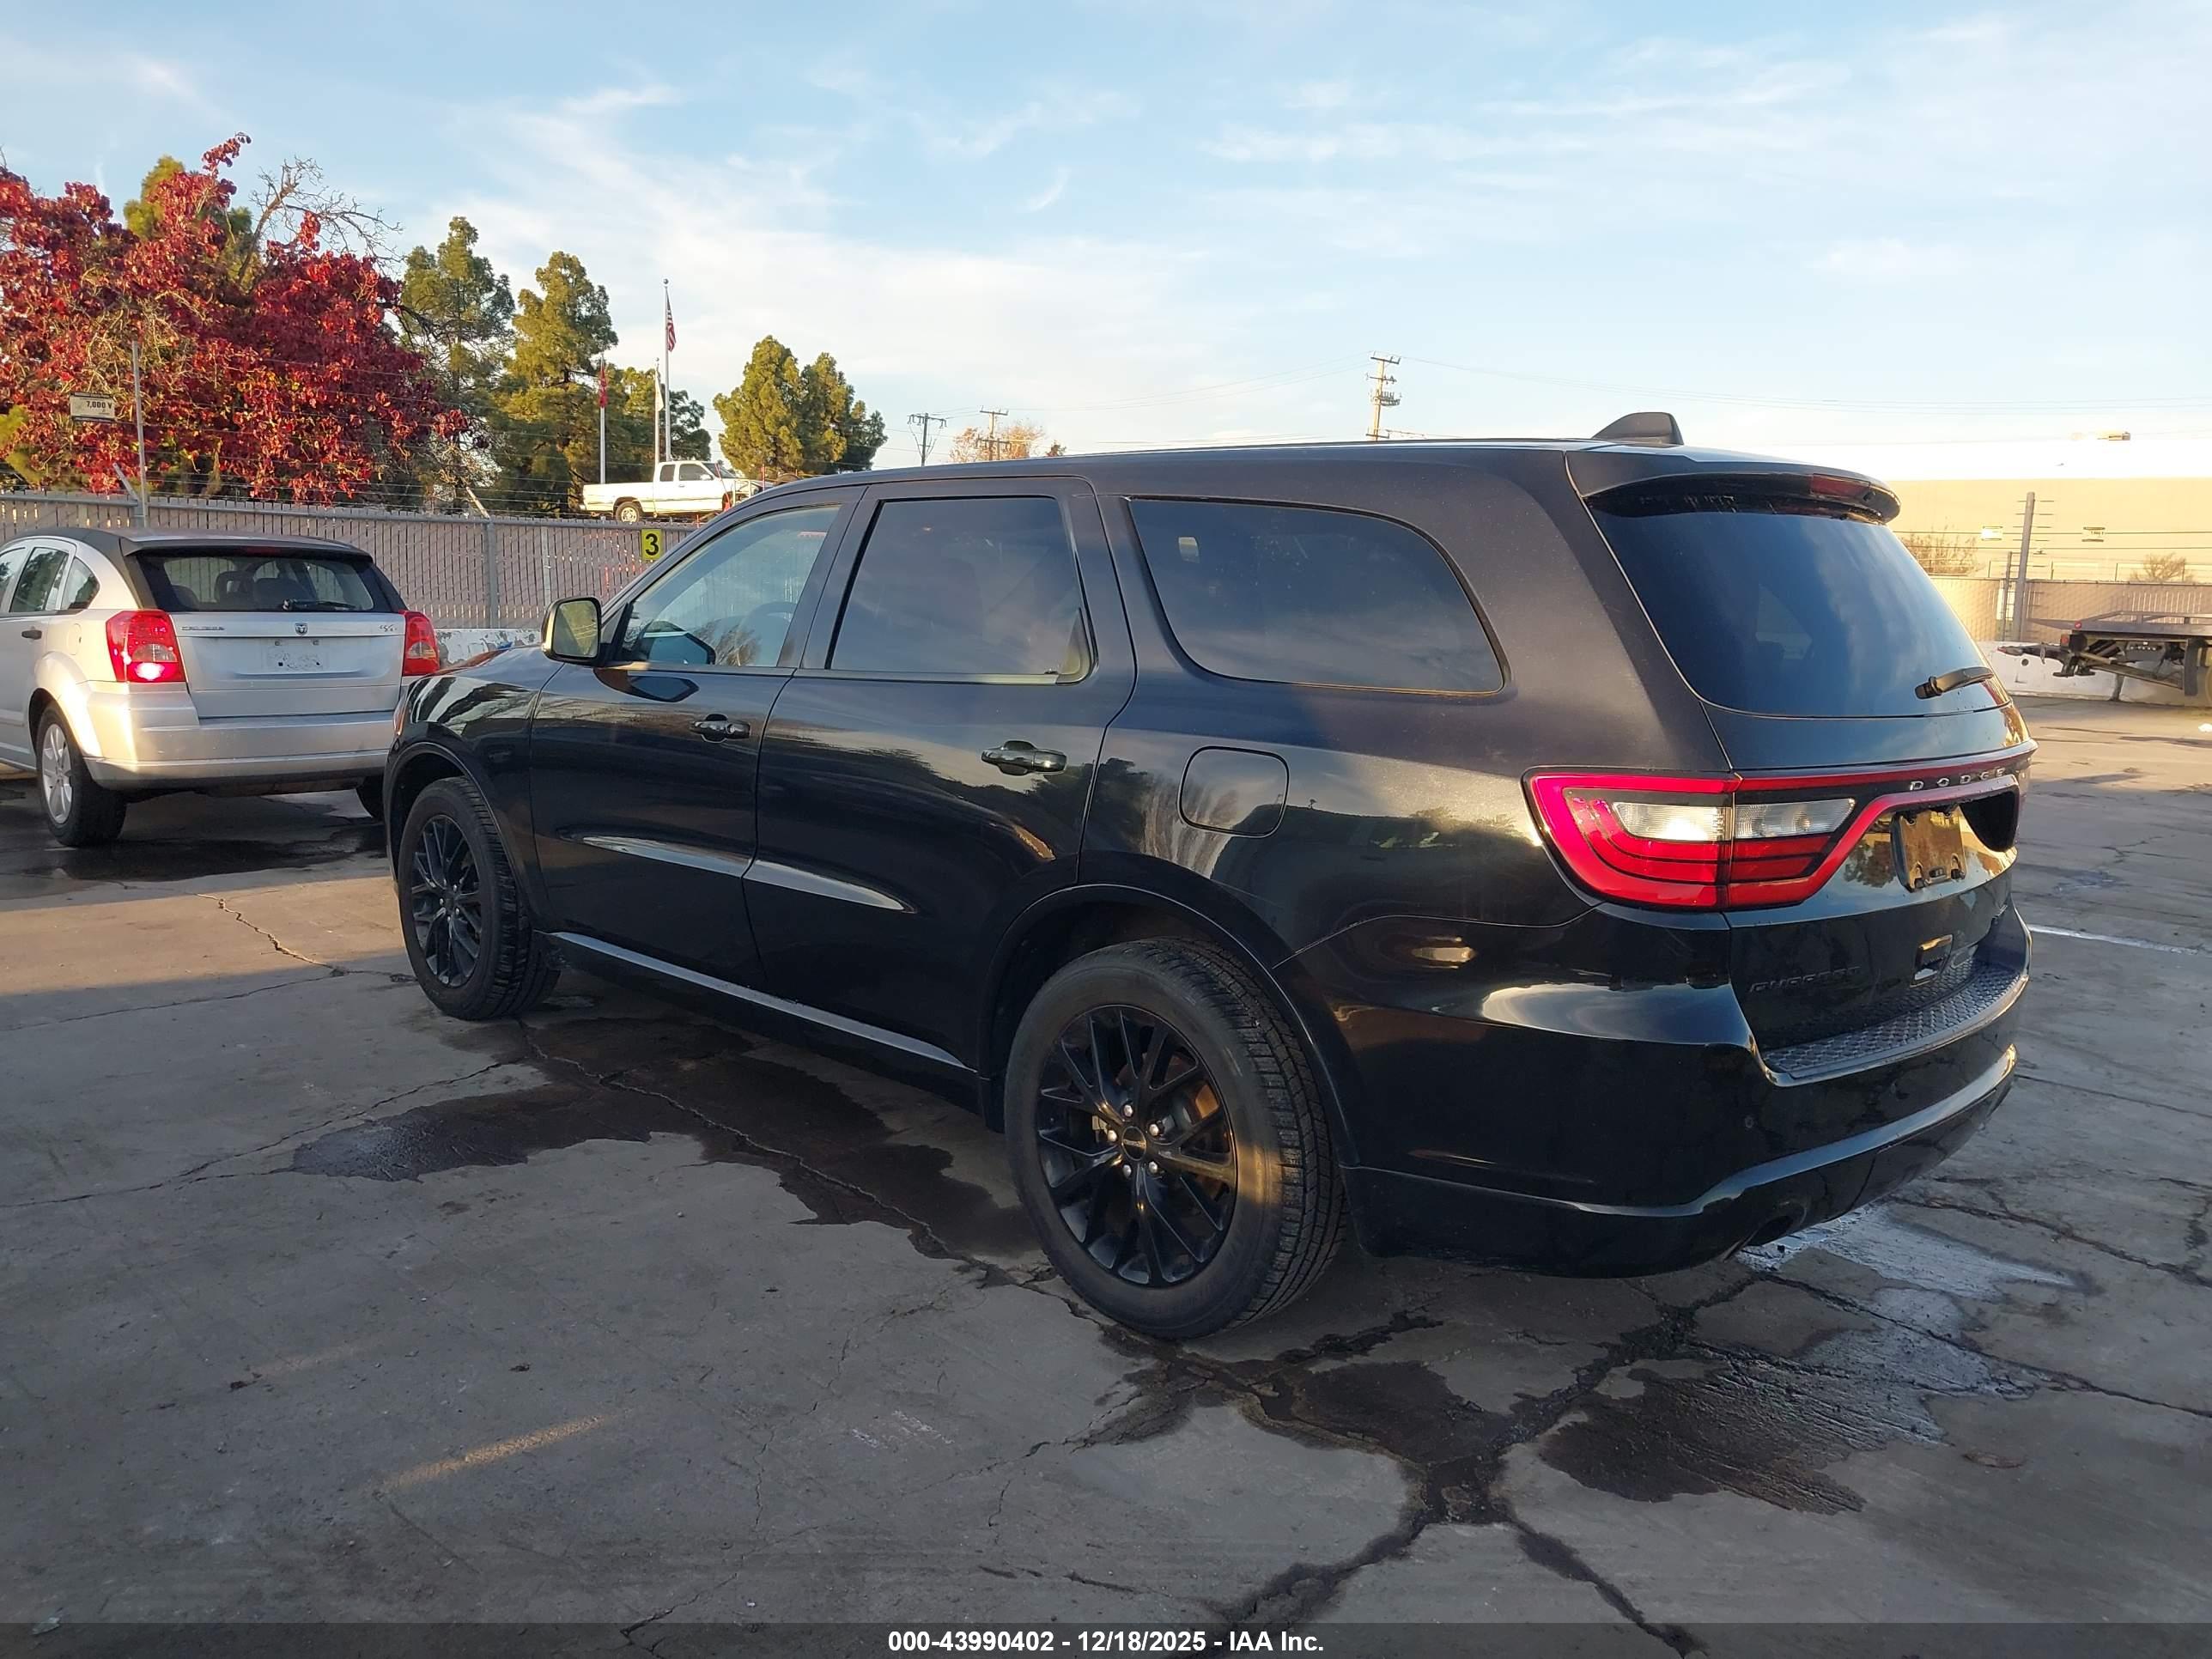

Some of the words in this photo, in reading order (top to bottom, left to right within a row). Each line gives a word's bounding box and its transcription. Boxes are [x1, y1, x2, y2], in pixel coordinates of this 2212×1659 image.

[86, 400, 106, 410] 7,000
[107, 401, 112, 410] V
[645, 532, 659, 556] 3
[1909, 767, 2006, 791] DODGE
